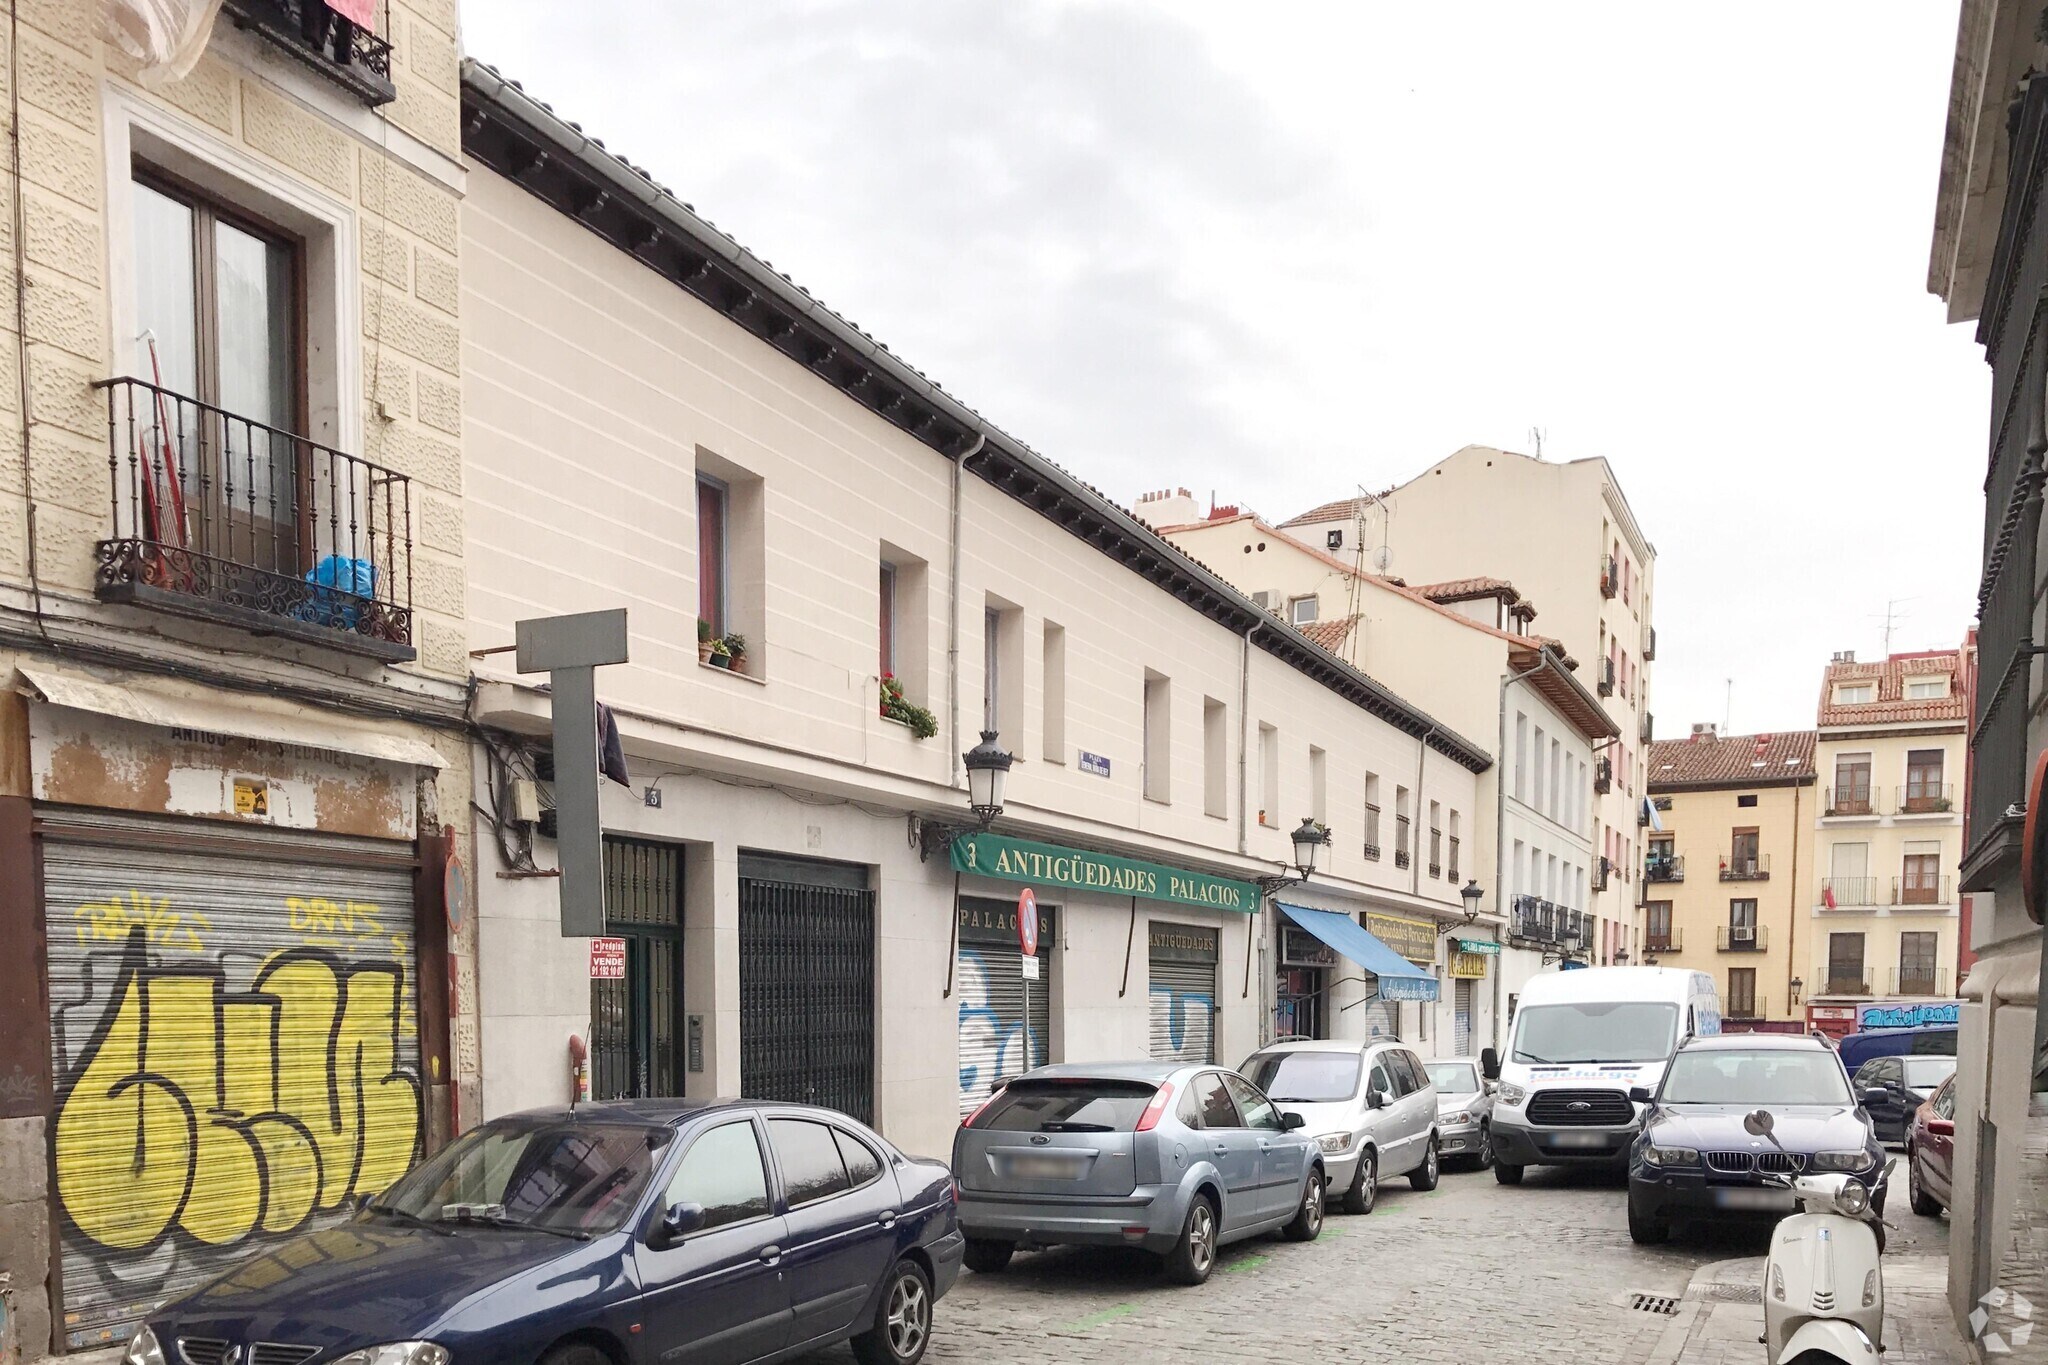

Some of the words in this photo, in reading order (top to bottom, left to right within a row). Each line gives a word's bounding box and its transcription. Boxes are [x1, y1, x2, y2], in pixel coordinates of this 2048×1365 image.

[967, 842, 977, 868] 3
[995, 847, 1156, 894] ANTIGÜEDADES
[1170, 876, 1240, 907] PALACIOS
[1248, 892, 1256, 910] 3
[959, 909, 1048, 933] PALACS
[593, 957, 624, 966] VENDE
[591, 965, 599, 976] 91
